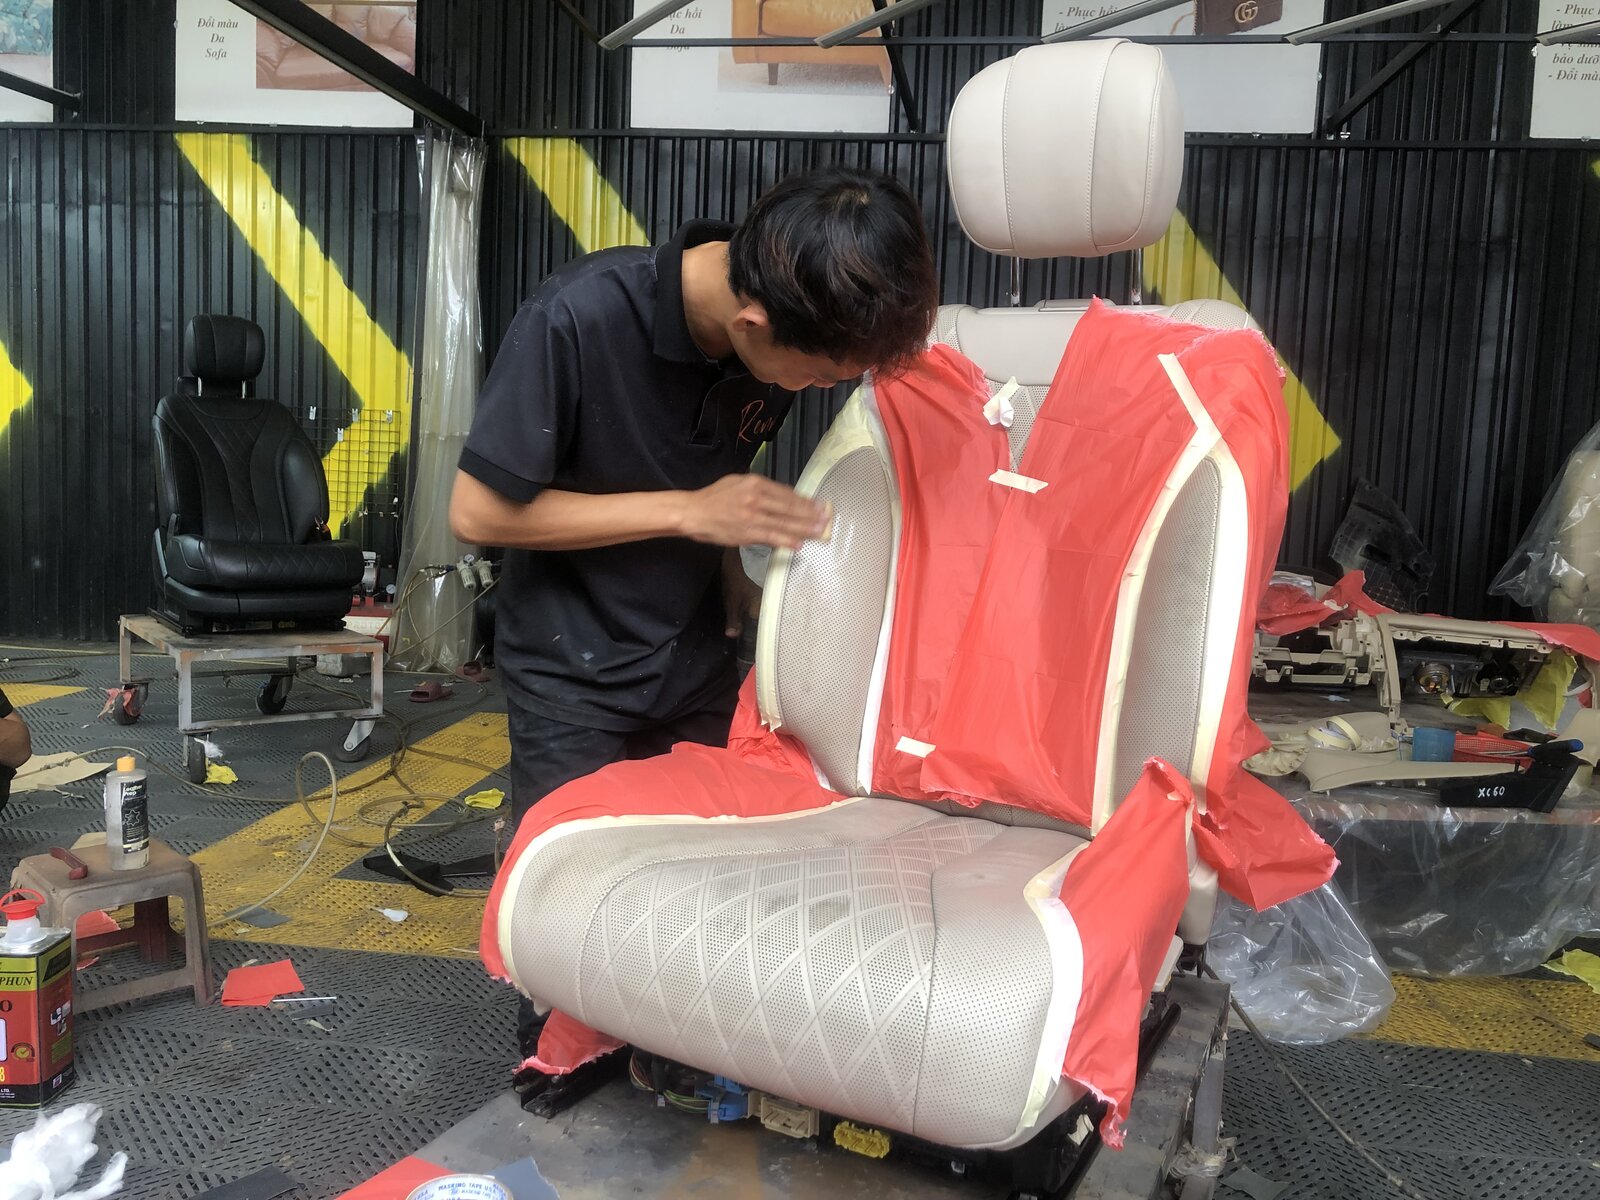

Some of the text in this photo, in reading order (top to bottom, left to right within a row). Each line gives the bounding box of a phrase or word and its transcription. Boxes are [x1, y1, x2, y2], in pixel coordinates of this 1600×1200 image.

[1066, 6, 1096, 20] Phục
[1564, 4, 1595, 18] Phục
[217, 18, 239, 28] màu
[670, 24, 686, 34] Da
[210, 33, 225, 43] Da
[204, 47, 227, 60] Sofa
